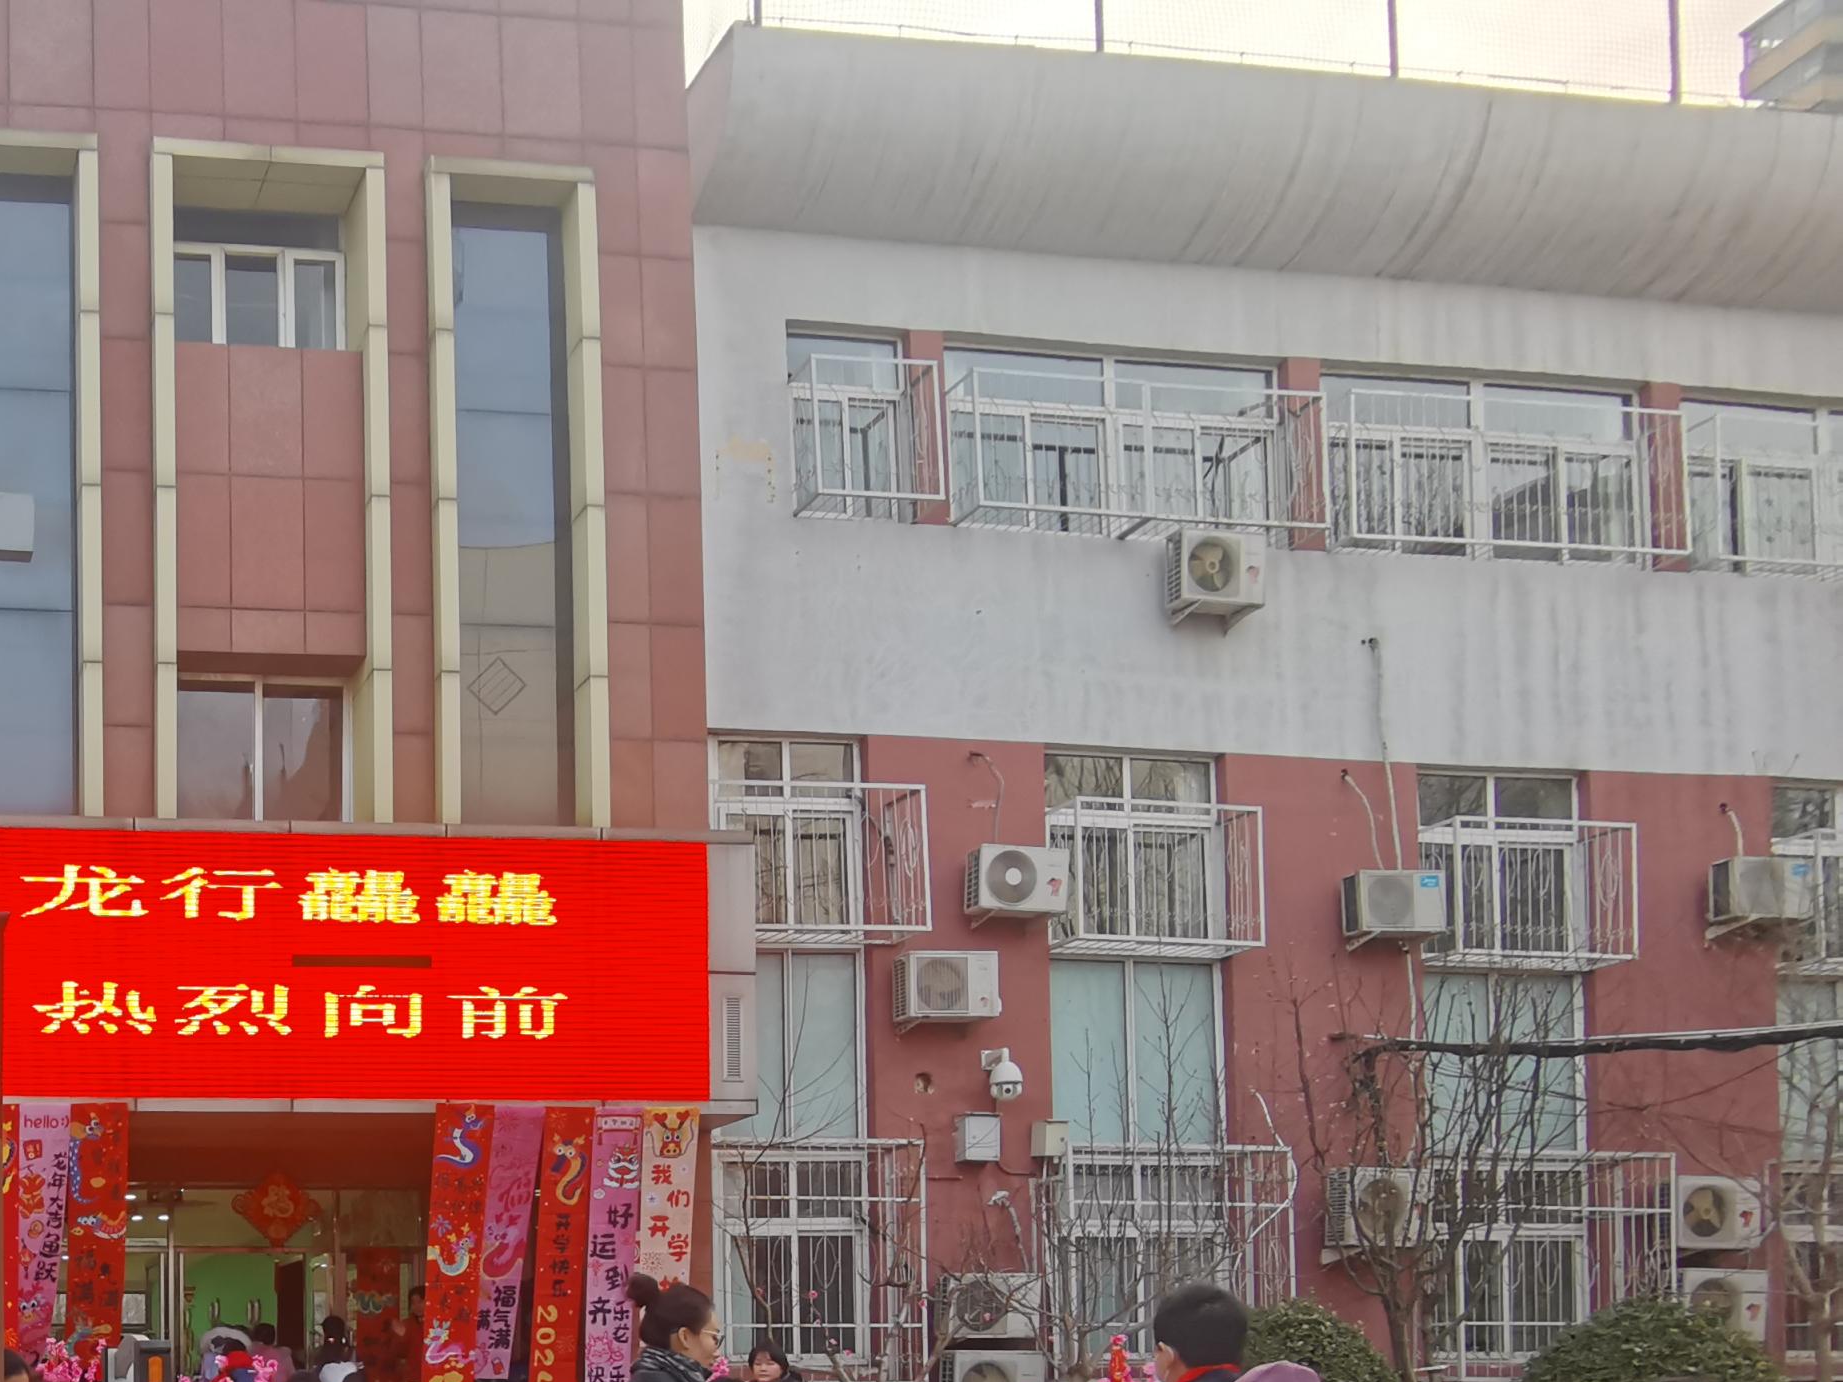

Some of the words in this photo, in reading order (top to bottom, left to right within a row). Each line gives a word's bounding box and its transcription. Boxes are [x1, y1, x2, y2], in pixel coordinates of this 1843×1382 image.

[20, 864, 558, 926] 龙行龘龘
[32, 980, 568, 1040] 热烈向前
